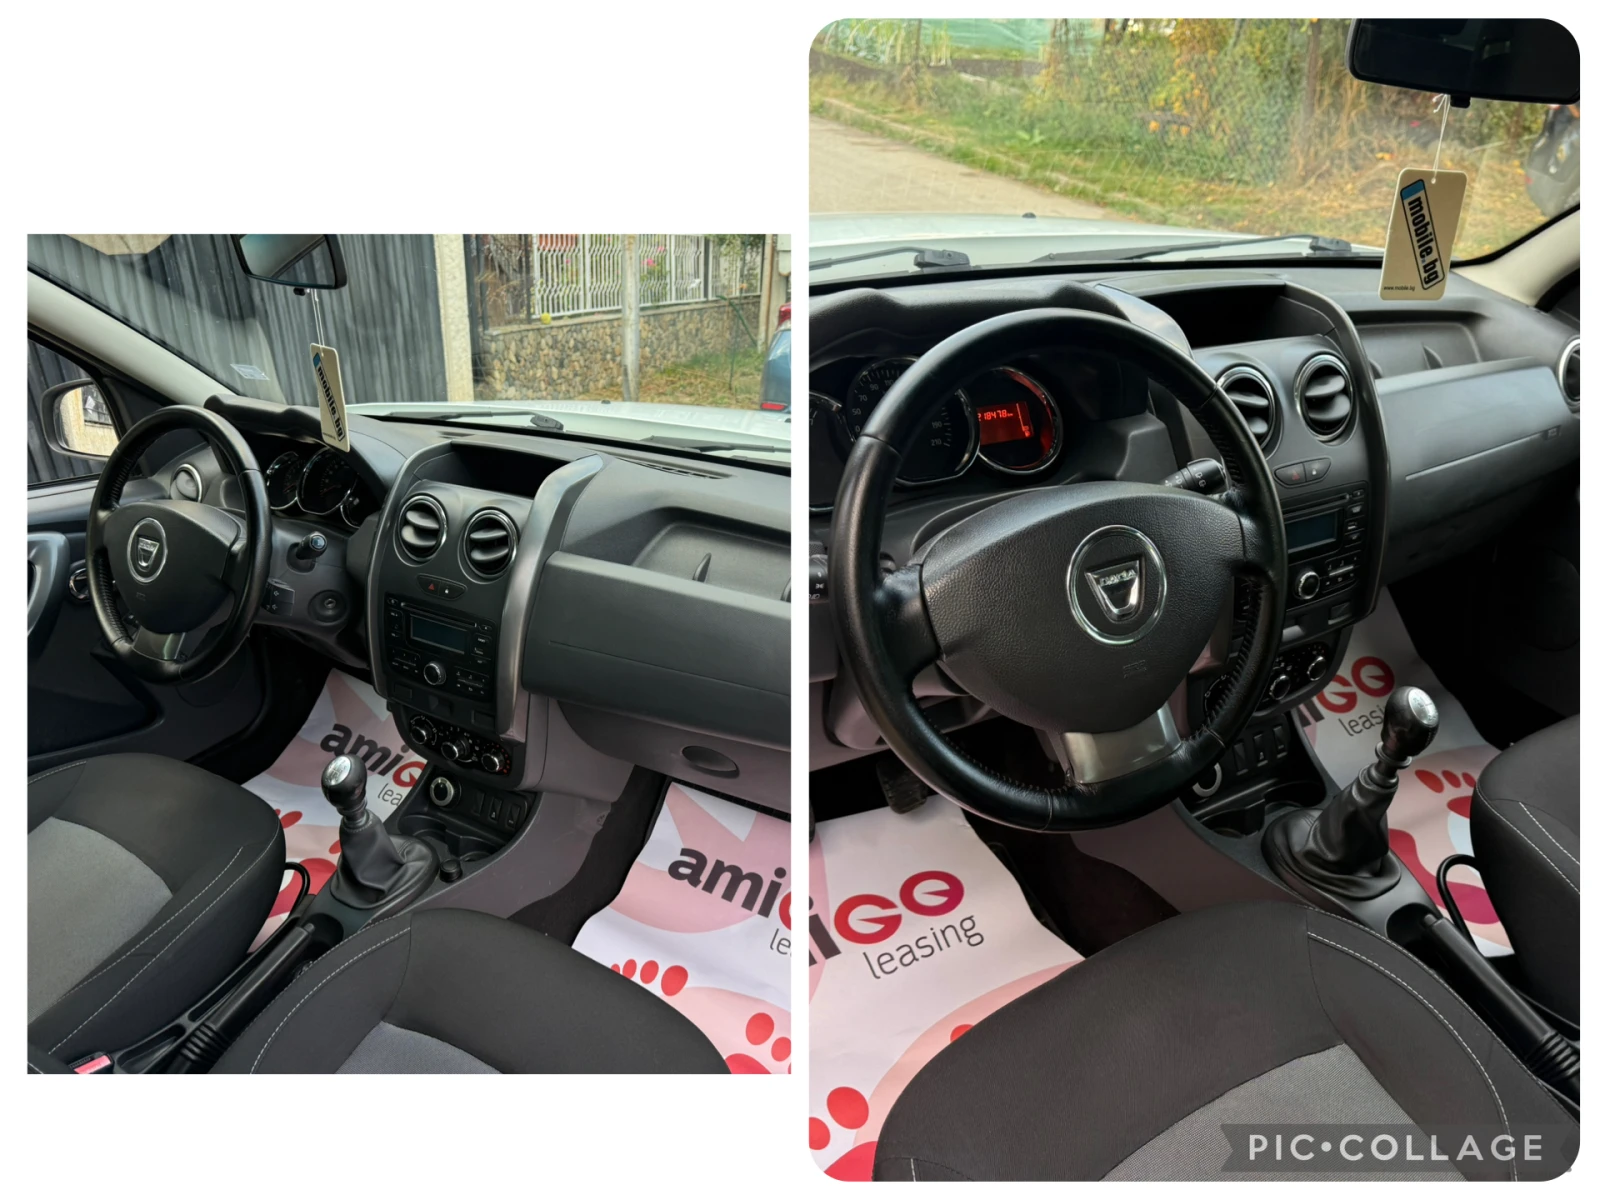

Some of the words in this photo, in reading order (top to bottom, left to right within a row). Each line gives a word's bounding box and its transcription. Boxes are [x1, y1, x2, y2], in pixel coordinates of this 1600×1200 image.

[1408, 196, 1440, 284] mobile.bg
[1383, 284, 1416, 292] www.mobile.bg
[318, 366, 343, 437] mobile.bg
[851, 408, 862, 416] 50
[858, 394, 868, 402] 70
[862, 915, 985, 980] leasing
